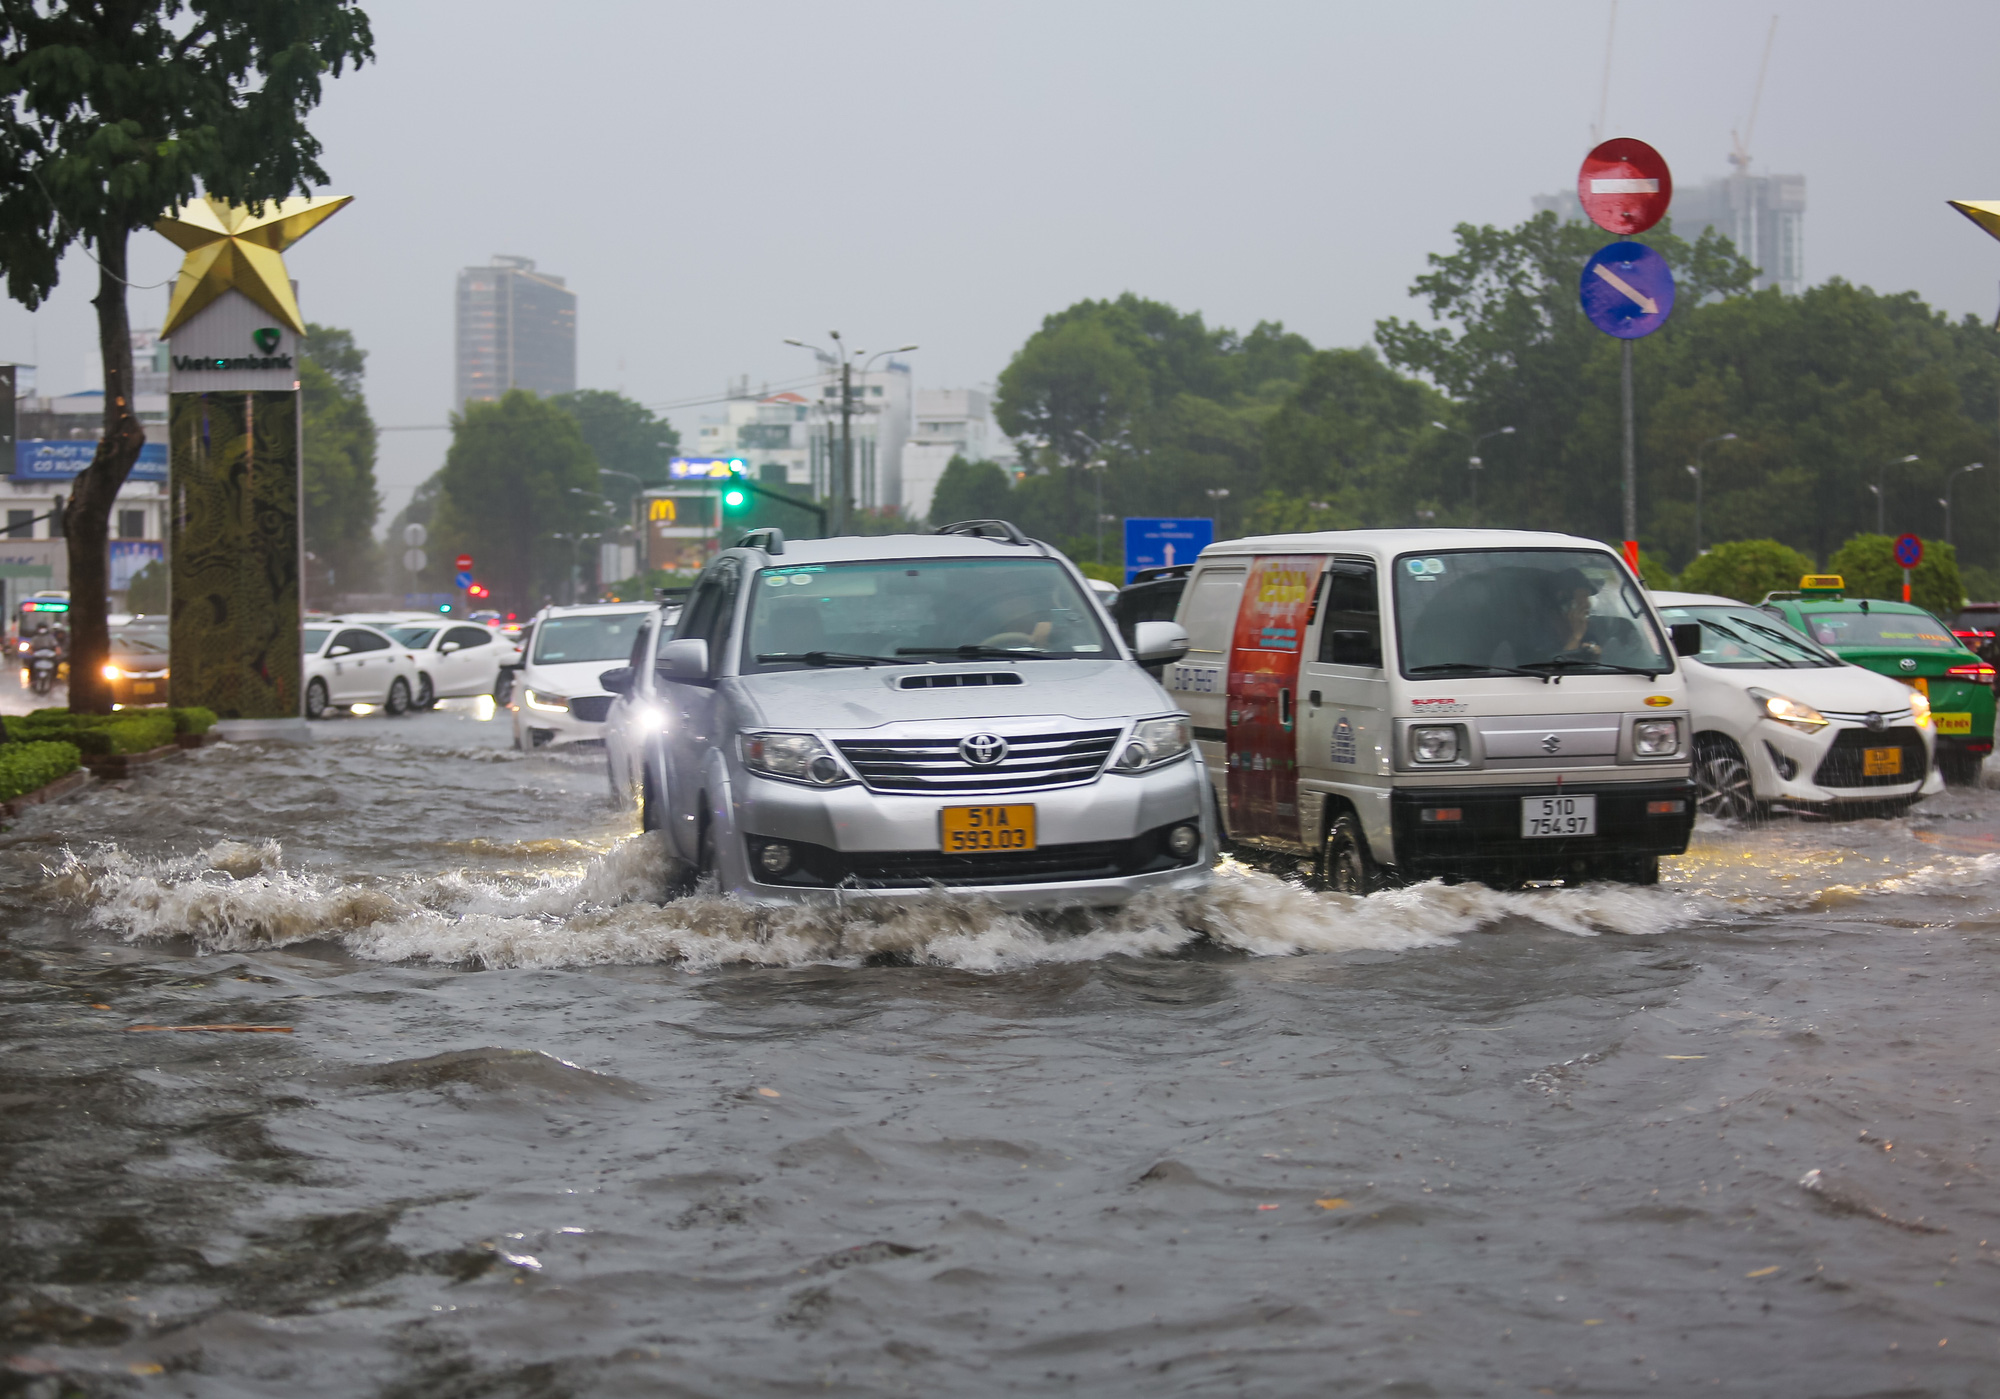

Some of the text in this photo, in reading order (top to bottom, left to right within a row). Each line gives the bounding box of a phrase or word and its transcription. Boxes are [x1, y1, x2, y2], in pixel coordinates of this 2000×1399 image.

[172, 353, 293, 371] Vietcombank
[1411, 703, 1469, 714] CARRY
[1542, 799, 1575, 815] 51D
[968, 807, 1010, 827] 51A
[1530, 817, 1588, 835] 754.97
[953, 828, 1027, 850] 593.03
